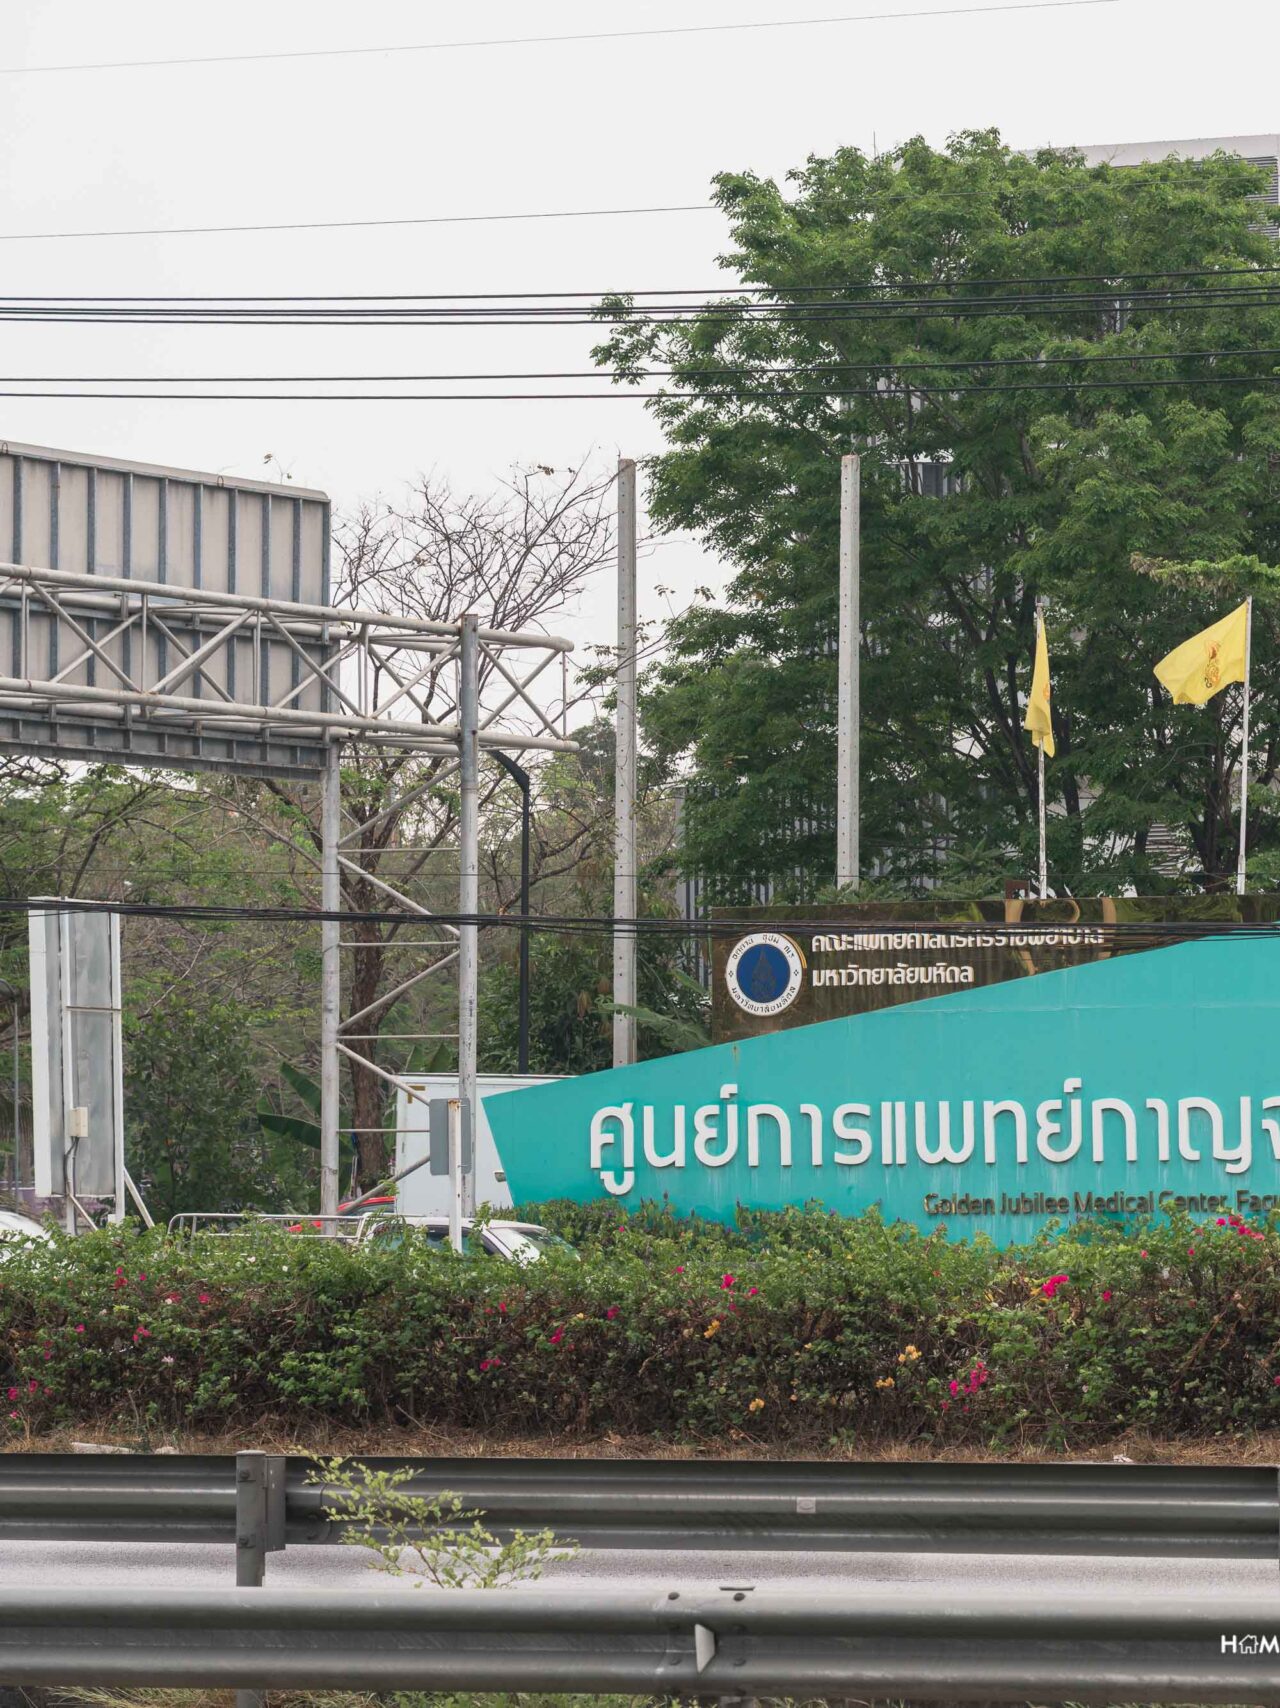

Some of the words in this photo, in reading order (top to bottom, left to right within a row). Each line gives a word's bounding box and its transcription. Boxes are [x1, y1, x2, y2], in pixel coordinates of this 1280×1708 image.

[812, 963, 974, 987] มหาวิทยาลัยมหิดล
[923, 1192, 995, 1216] Golden
[1000, 1191, 1070, 1215] Jubilee
[1073, 1190, 1155, 1214] Medical
